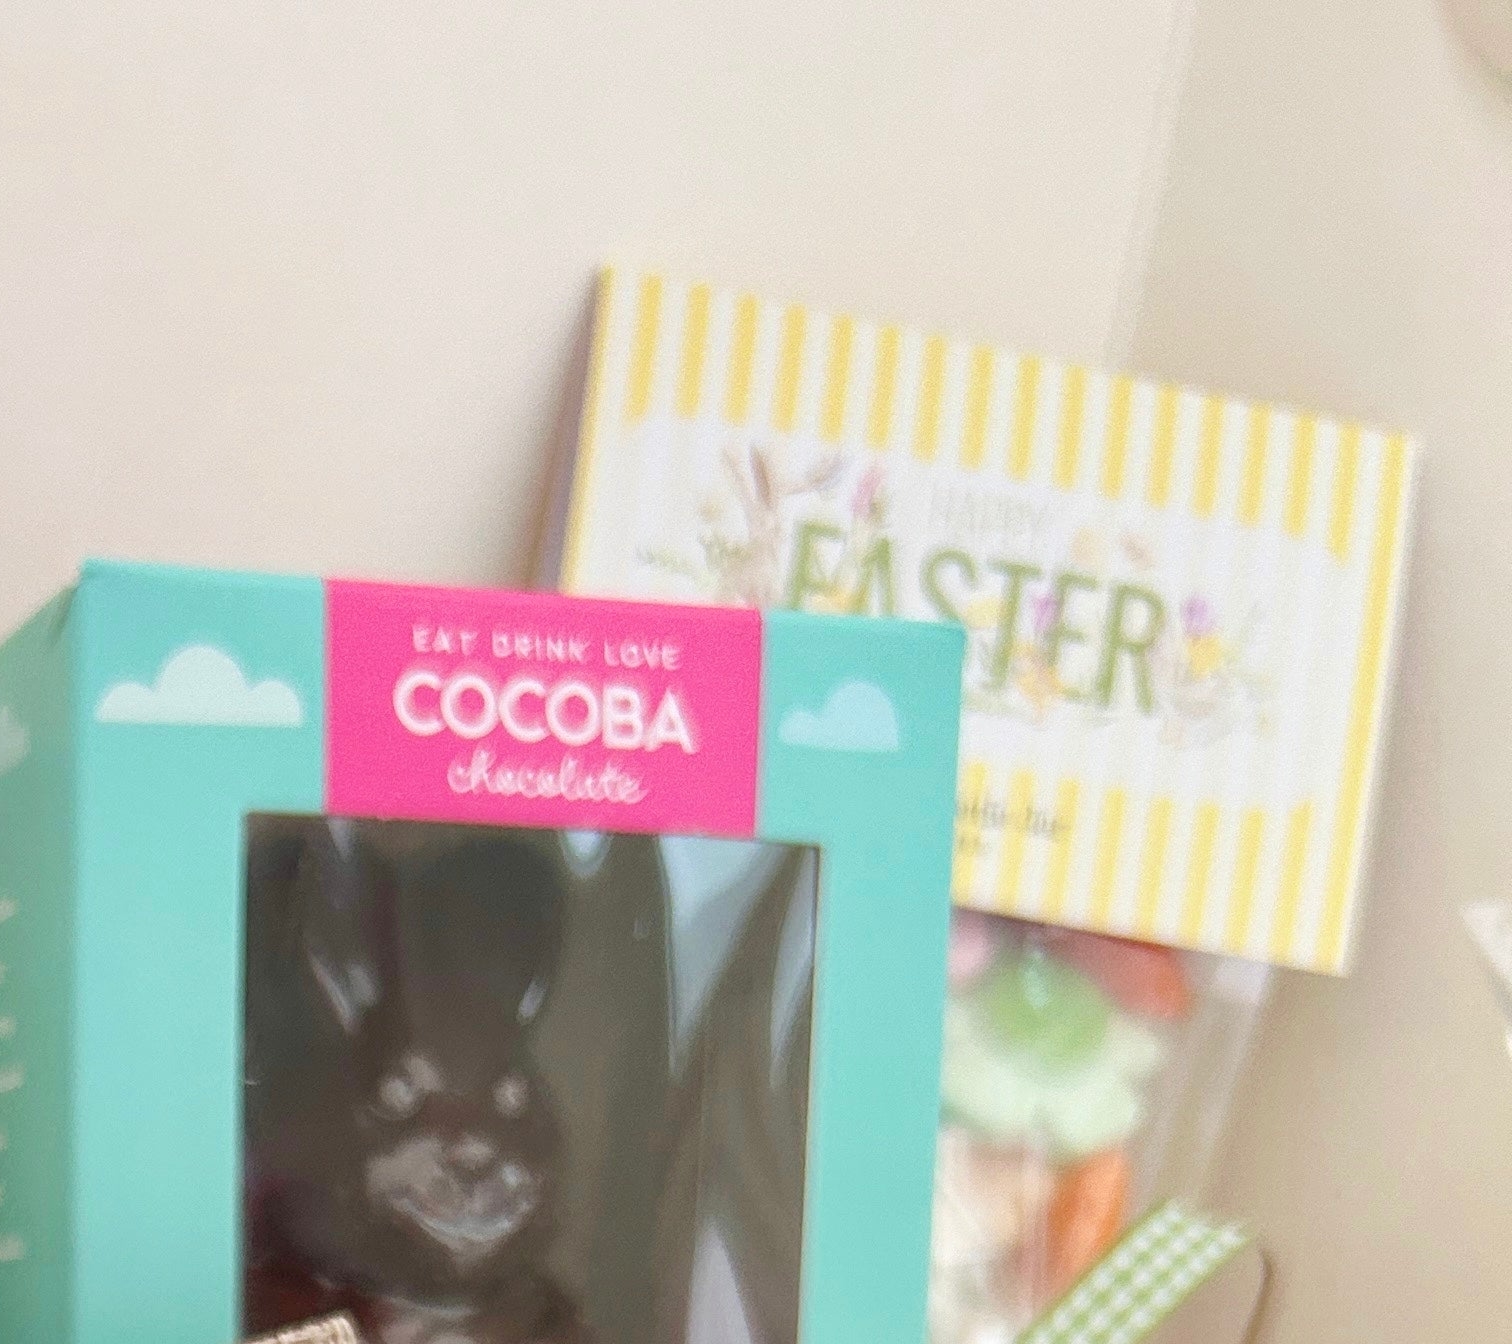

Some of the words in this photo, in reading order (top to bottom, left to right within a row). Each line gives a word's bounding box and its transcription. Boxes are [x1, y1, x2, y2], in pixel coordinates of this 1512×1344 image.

[412, 624, 478, 655] EAT
[492, 630, 590, 663] DRINK
[603, 640, 684, 671] LOVE
[392, 667, 700, 755] COCOBA
[447, 745, 649, 804] chocolate
